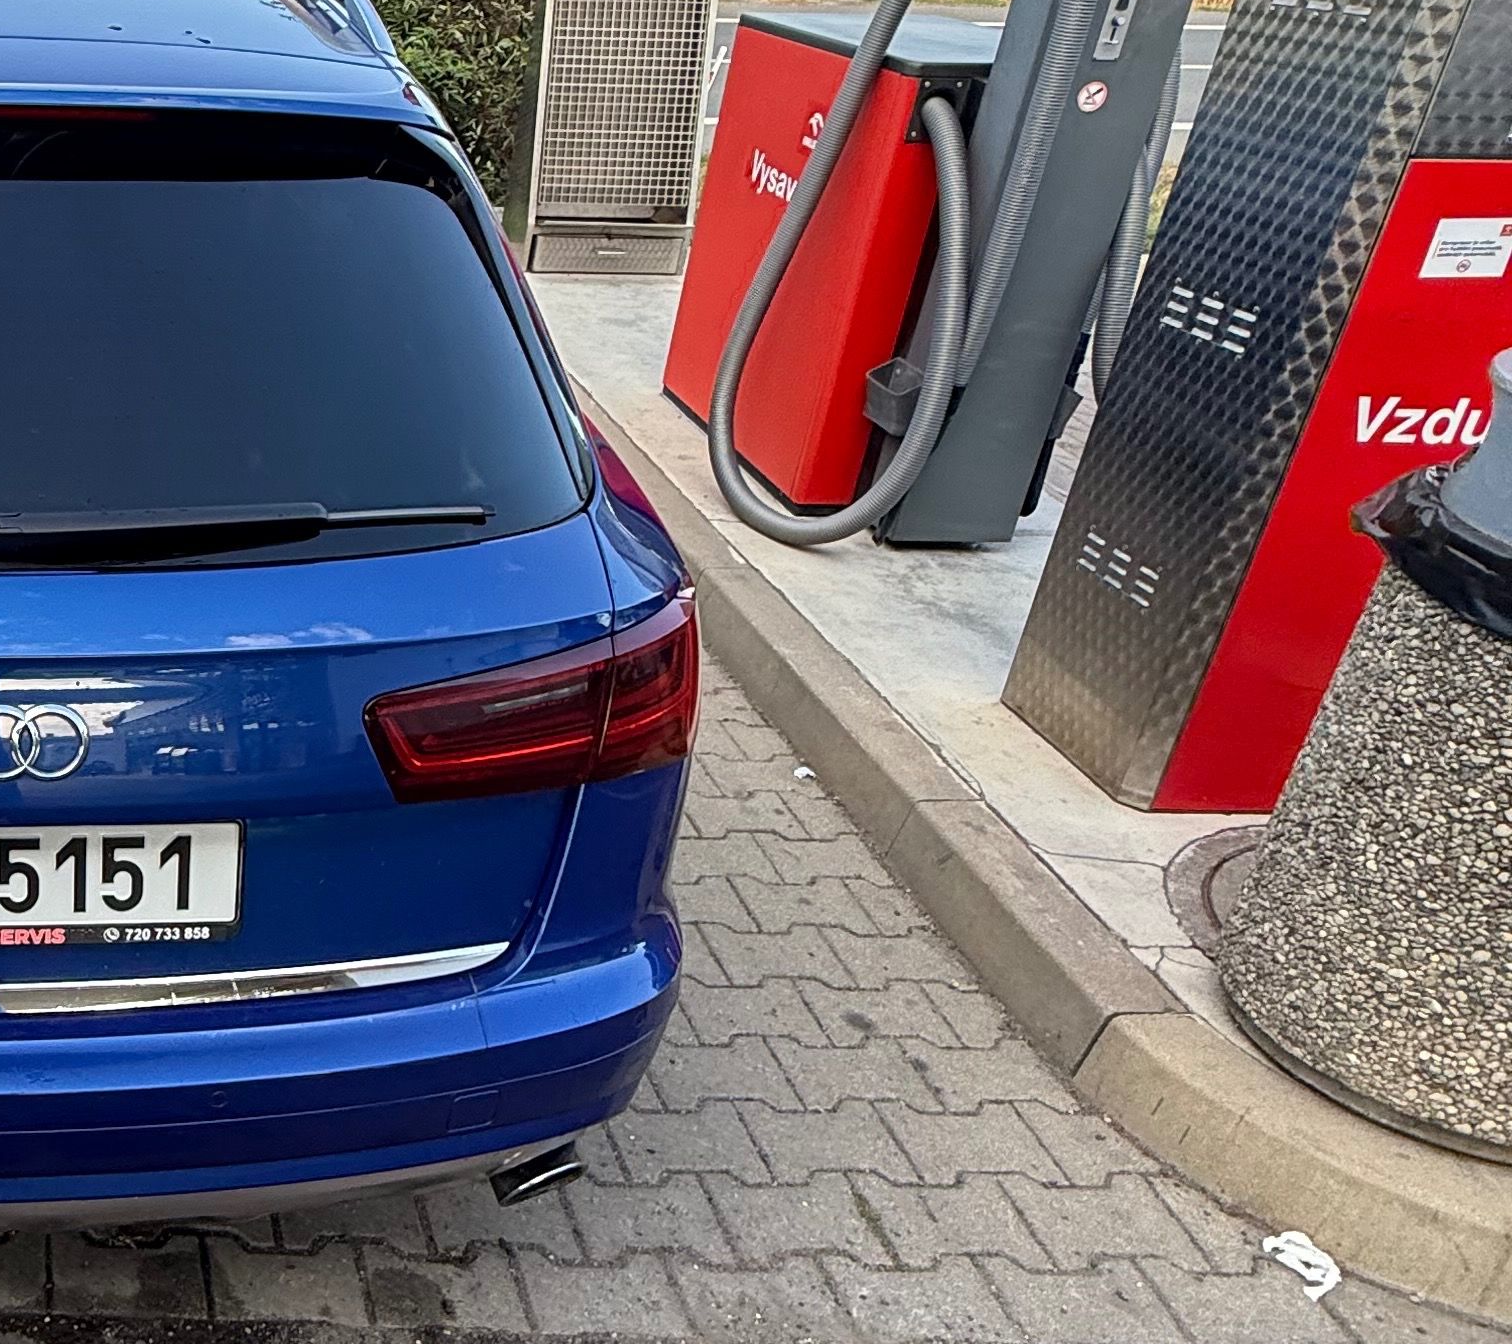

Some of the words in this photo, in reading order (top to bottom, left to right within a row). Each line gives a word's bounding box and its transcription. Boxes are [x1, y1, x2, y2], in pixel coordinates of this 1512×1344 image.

[1356, 395, 1492, 444] Vzdu
[124, 927, 150, 941] 720
[154, 927, 180, 940] 733
[183, 926, 210, 940] 858
